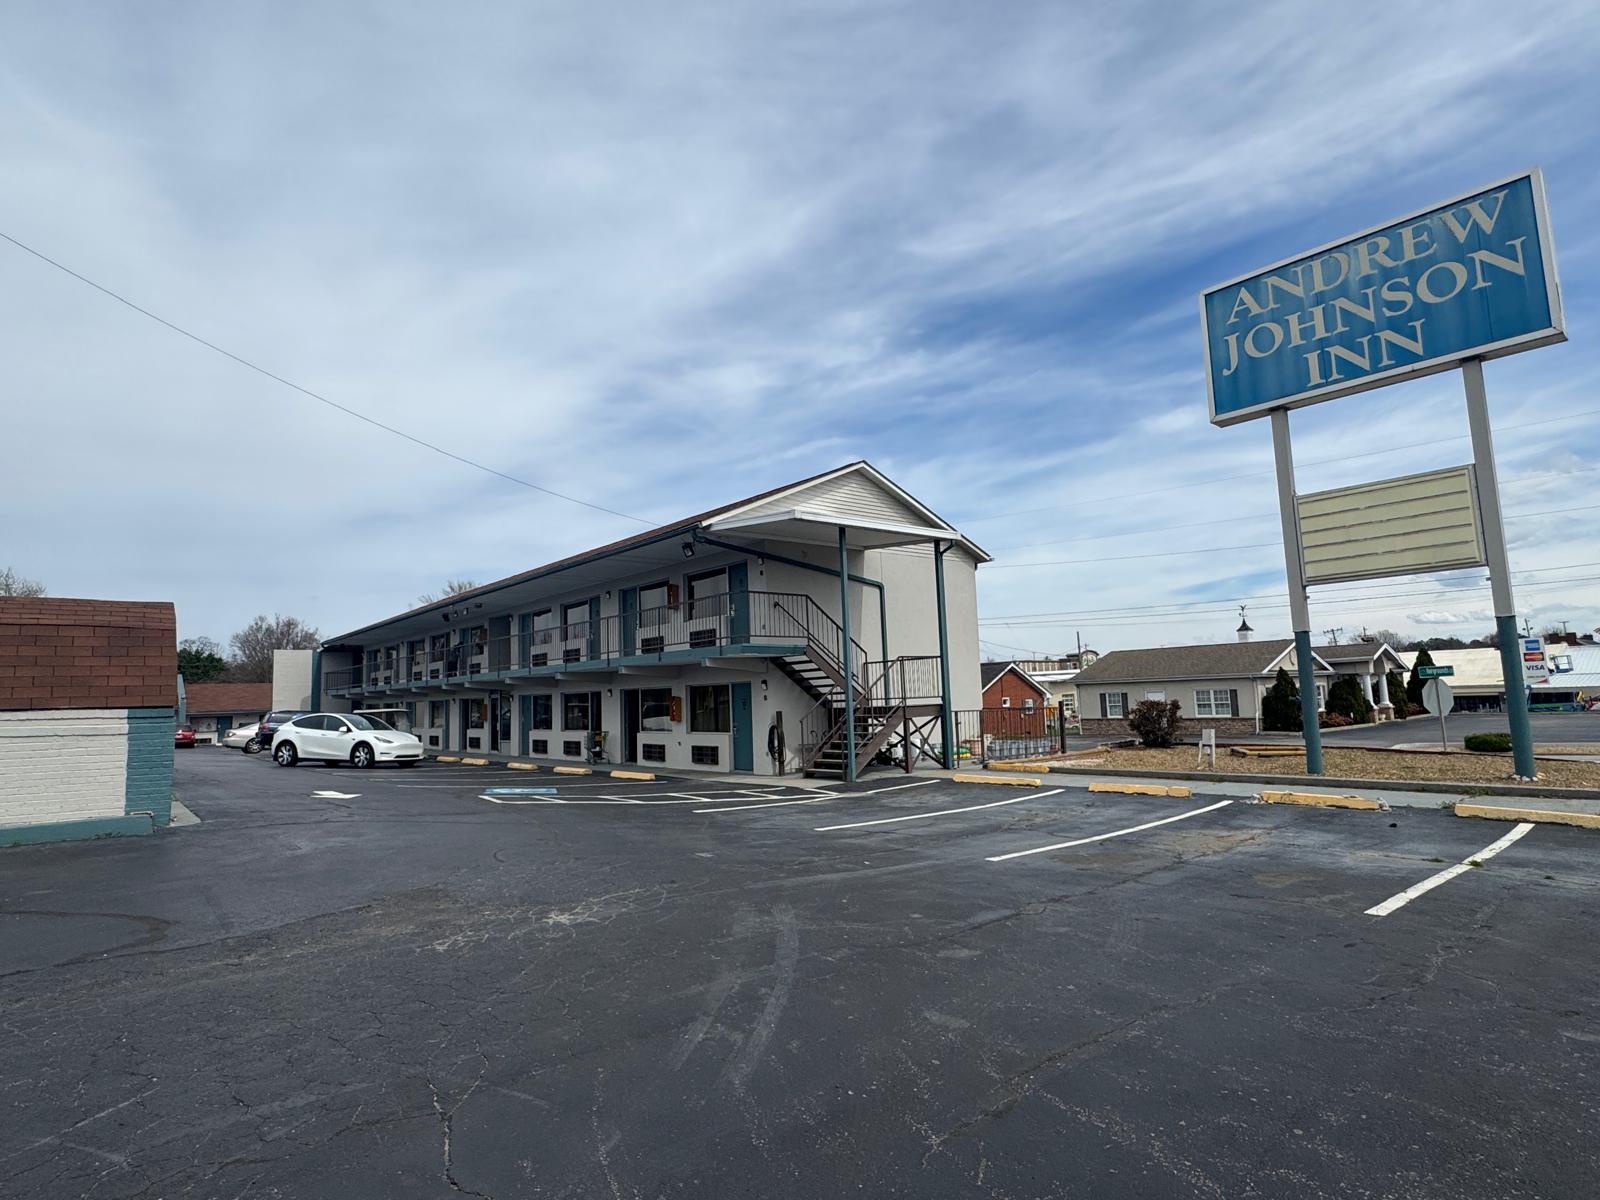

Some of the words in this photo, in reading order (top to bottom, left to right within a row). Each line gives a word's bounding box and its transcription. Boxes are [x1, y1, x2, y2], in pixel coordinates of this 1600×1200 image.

[1222, 236, 1527, 376] JOHNSON
[1226, 189, 1510, 325] ANDREW
[1302, 318, 1426, 387] INN
